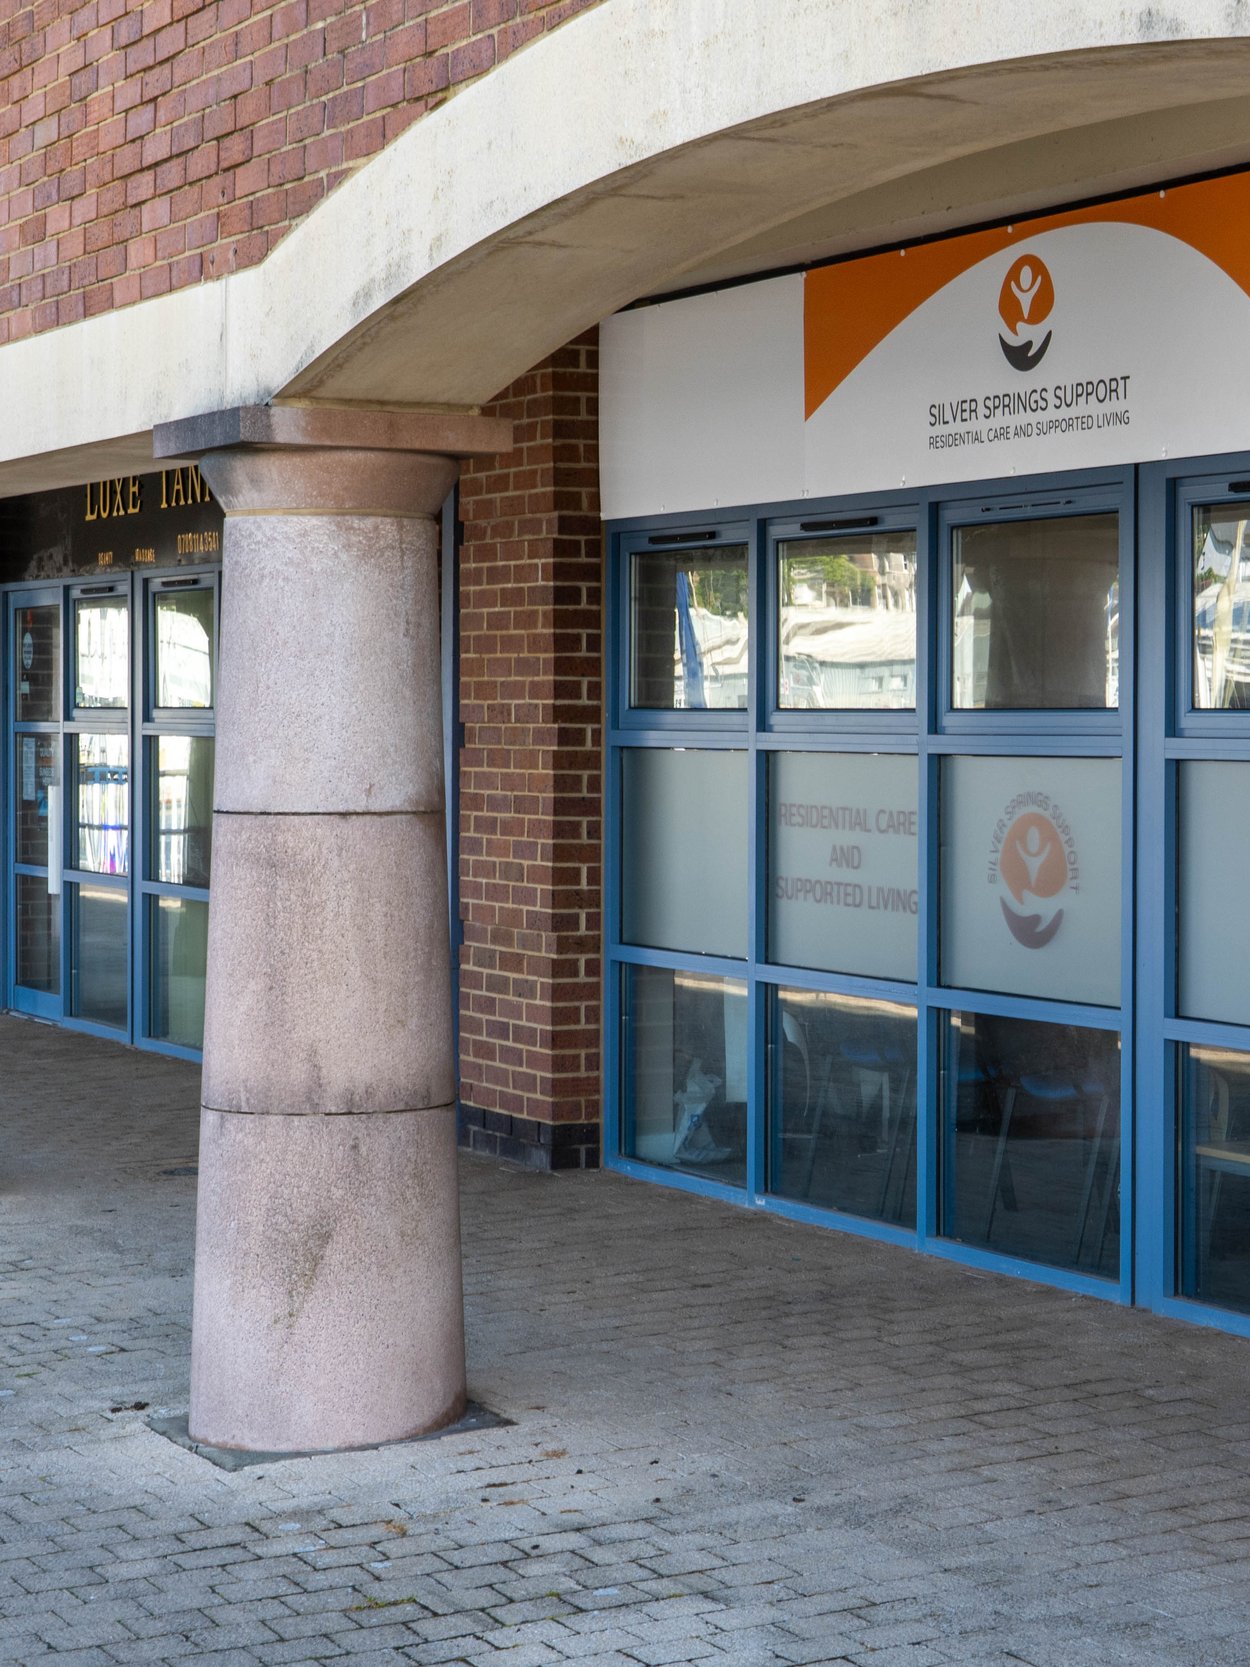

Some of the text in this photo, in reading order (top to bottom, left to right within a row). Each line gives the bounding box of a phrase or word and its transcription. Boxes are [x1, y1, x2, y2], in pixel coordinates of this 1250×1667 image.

[928, 375, 1131, 427] SILVER SPRINGS SUPPORT
[928, 410, 1130, 450] RESIDENTIAL CARE AND SUPPORTED LIVING
[85, 475, 141, 521] LUXE
[778, 802, 917, 836] RESIDENTIAL CARE
[828, 844, 862, 870] AND
[987, 818, 1008, 884] SILVER
[775, 876, 919, 915] SUPPORTED LIVING
